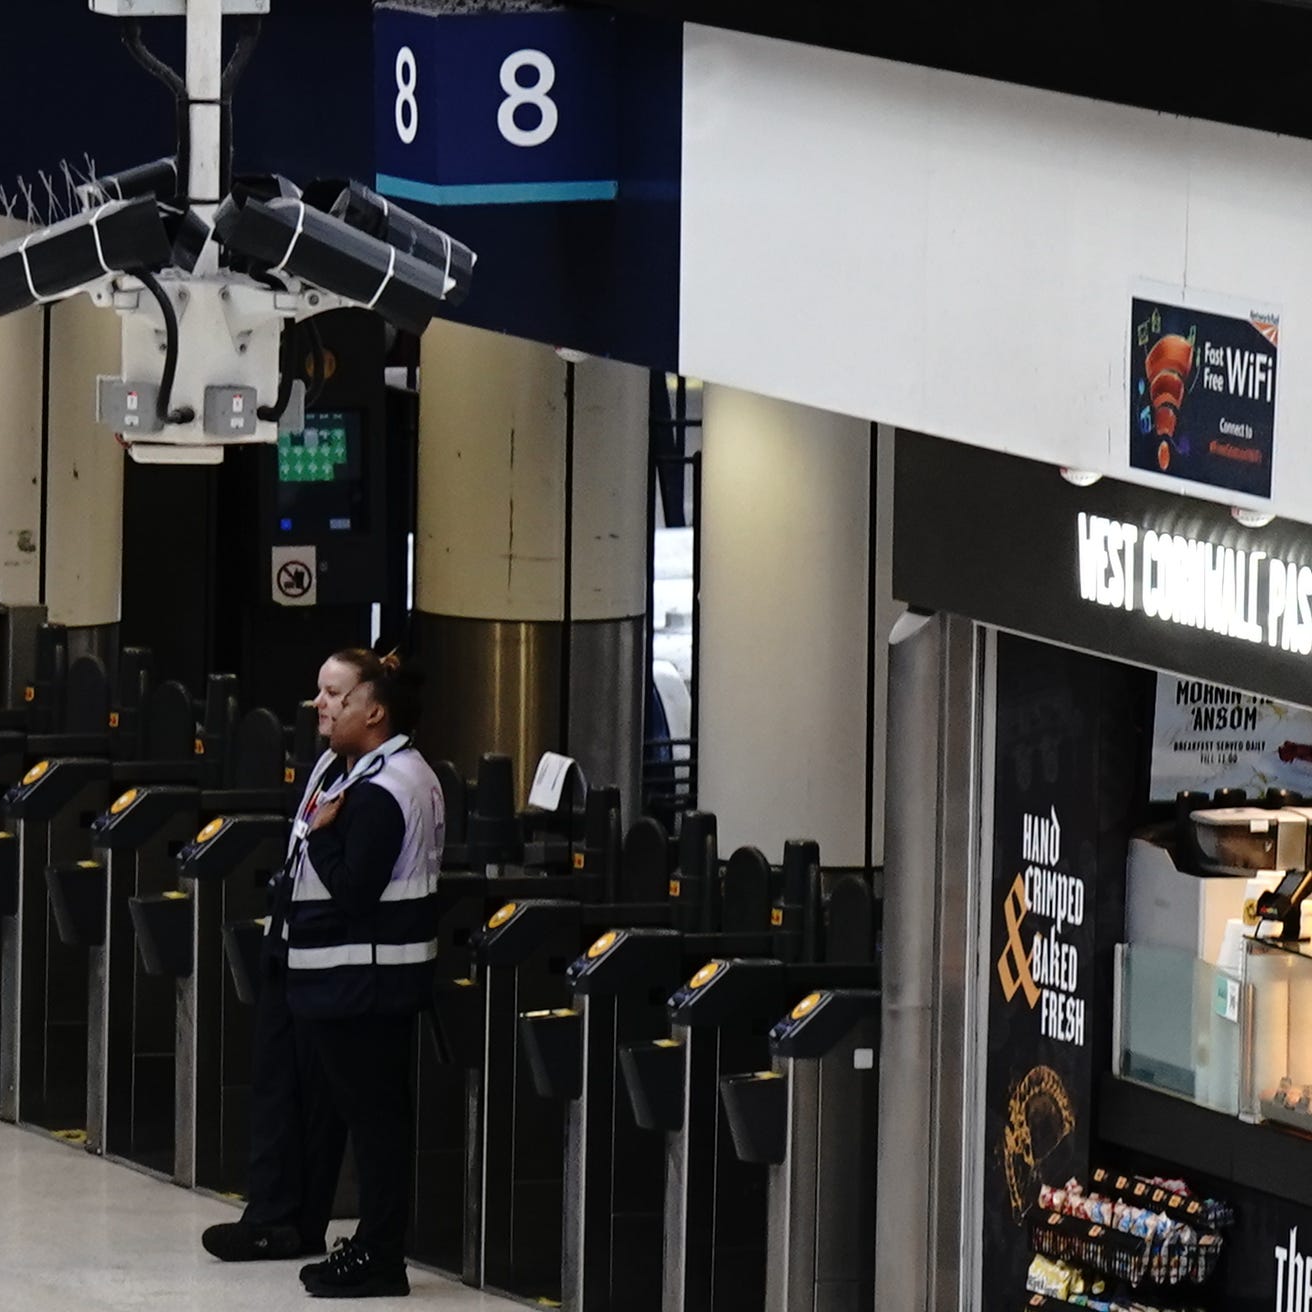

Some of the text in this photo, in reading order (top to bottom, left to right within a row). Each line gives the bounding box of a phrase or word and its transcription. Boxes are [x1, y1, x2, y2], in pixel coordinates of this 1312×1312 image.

[394, 45, 419, 145] 8
[496, 48, 559, 147] 8
[1203, 365, 1225, 393] Free
[1204, 341, 1225, 367] Fast
[1226, 346, 1274, 403] WiFi
[1219, 417, 1254, 439] Connect to
[1077, 511, 1139, 611] WEST
[1142, 529, 1267, 644] CORNWALL
[1173, 740, 1266, 752] BREAKFAST SERVED DAILY
[1022, 804, 1062, 867] HAND
[1023, 863, 1085, 934] CRIMPED
[1032, 924, 1079, 993] BAKED
[1040, 988, 1086, 1047] FRESH
